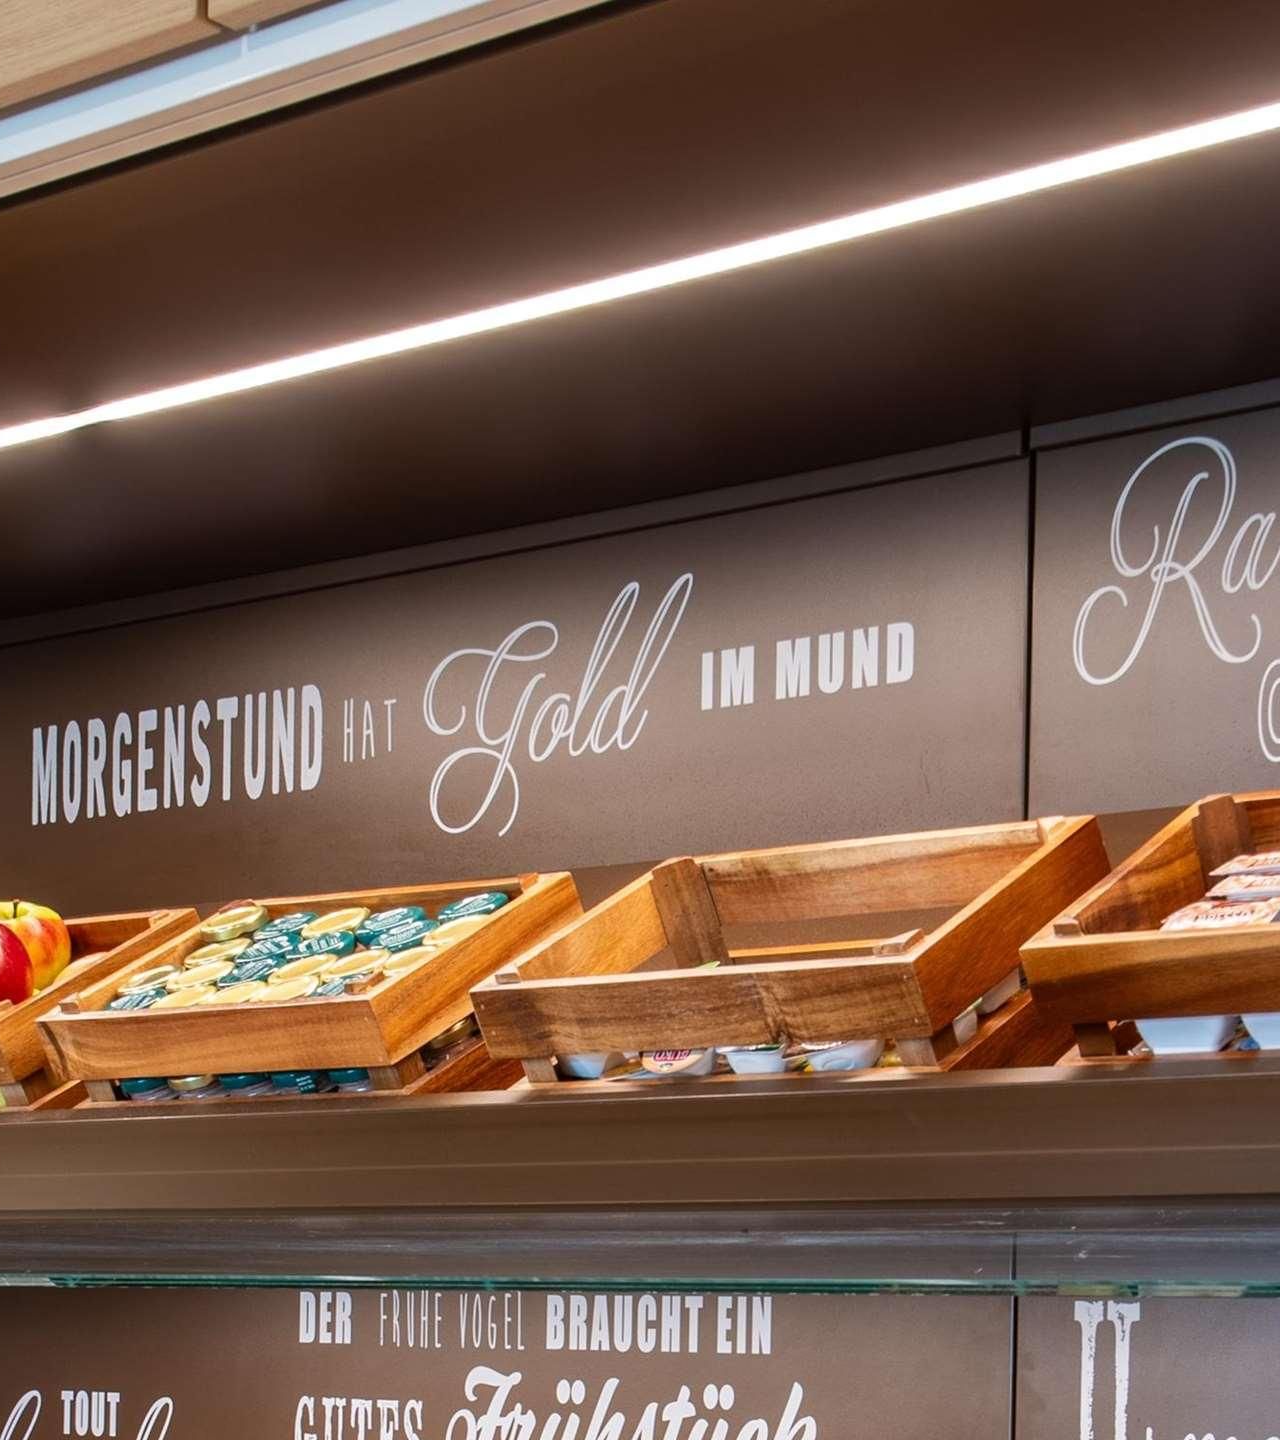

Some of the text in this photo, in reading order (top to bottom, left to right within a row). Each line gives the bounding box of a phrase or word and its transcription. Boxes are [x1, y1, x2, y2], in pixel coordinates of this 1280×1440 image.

[31, 572, 916, 838] MORGENSTUND HAT Gold IM MUND
[298, 1291, 353, 1345] DER
[545, 1294, 704, 1353] BRAUCHT
[715, 1295, 774, 1356] EIN
[61, 1389, 121, 1438] TOUT
